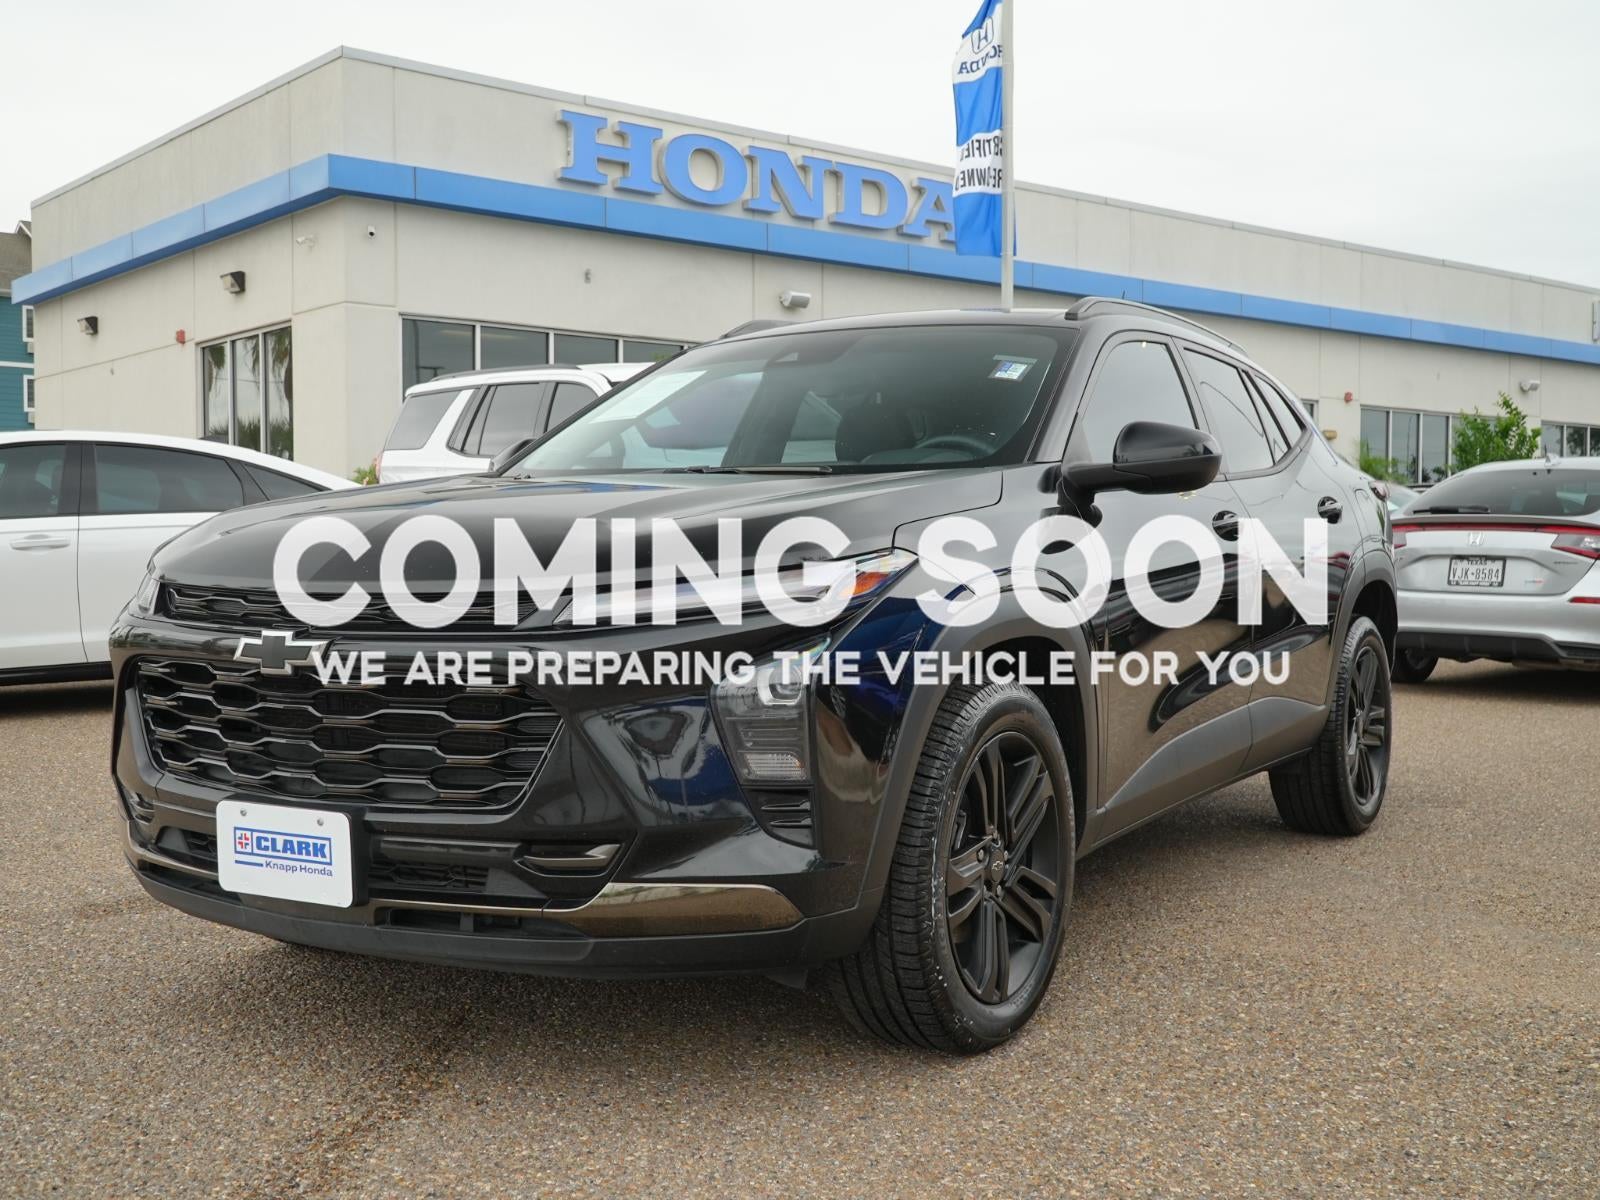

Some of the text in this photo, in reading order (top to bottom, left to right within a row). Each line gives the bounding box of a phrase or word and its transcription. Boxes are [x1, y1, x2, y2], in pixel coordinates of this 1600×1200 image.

[556, 109, 955, 243] HONDA
[255, 835, 327, 859] CLARK
[265, 860, 333, 877] Knapp Honda
